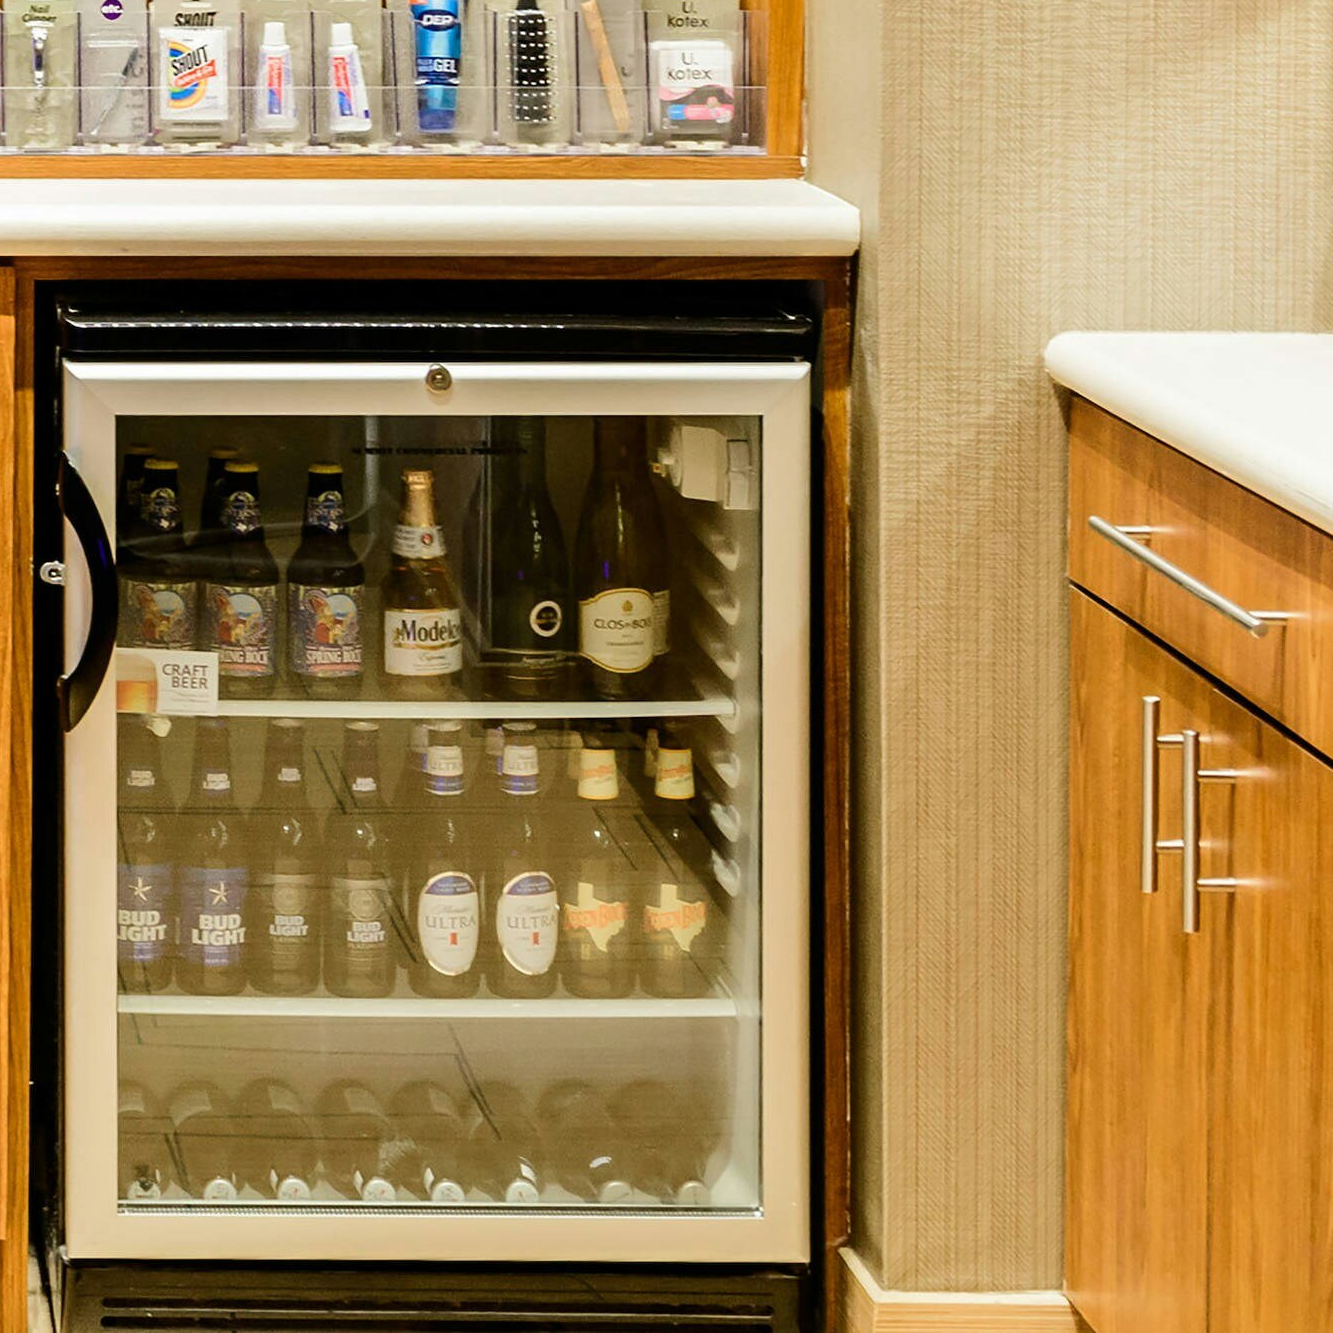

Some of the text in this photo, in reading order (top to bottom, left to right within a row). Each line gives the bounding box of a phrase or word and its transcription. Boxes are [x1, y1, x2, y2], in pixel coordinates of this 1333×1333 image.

[30, 4, 50, 15] Nail
[174, 12, 217, 27] SHOUT
[421, 15, 454, 25] DEP
[666, 14, 709, 28] kotex
[171, 45, 209, 76] SHOUT
[433, 59, 458, 73] GEL
[667, 68, 713, 81] kotex
[162, 664, 209, 676] CRAFT
[171, 676, 208, 689] BEER
[118, 910, 161, 927] BUD
[199, 914, 242, 930] BUD
[275, 915, 305, 927] BUD
[425, 916, 476, 930] ULTRA
[269, 924, 309, 937] LIGHT
[352, 921, 382, 933] BUD
[192, 927, 246, 946] LIGHT
[347, 930, 386, 943] LIGHT
